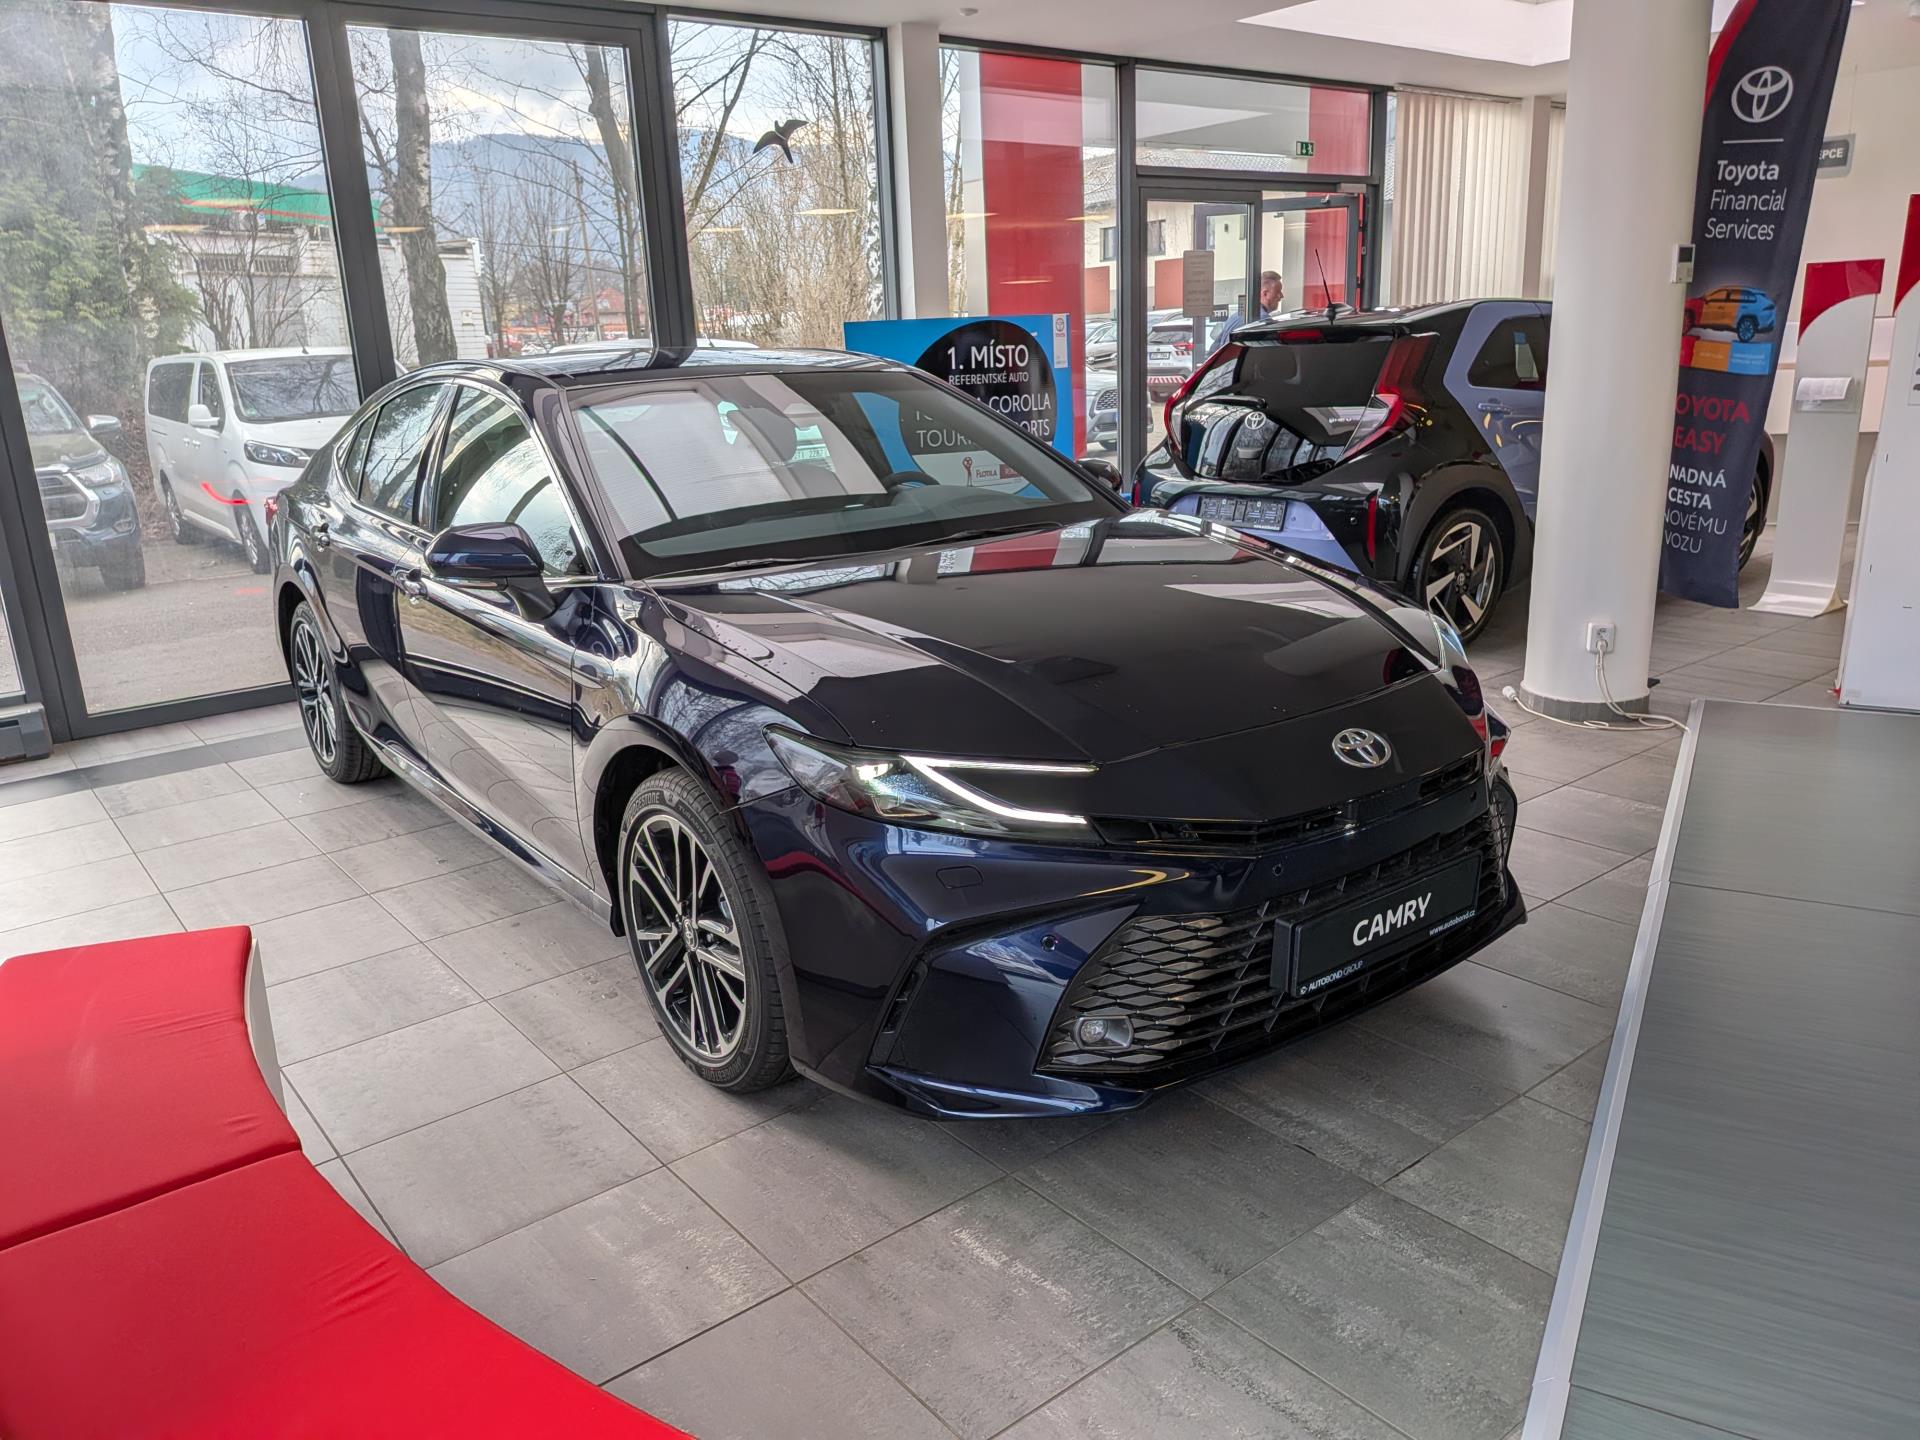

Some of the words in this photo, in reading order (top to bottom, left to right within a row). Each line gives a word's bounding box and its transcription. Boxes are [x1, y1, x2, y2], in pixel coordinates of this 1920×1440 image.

[1717, 160, 1780, 186] Toyota
[1710, 187, 1787, 212] Financial
[1705, 217, 1775, 241] Services
[947, 349, 964, 370] 1.
[971, 339, 1029, 369] MÍSTO
[948, 371, 1007, 386] REFERENTSKÉ
[1009, 371, 1029, 383] AUTO
[989, 393, 1052, 413] COROLLA
[1675, 392, 1752, 424] OYOTA
[1017, 419, 1050, 437] ORTS
[1674, 424, 1727, 456] EASY
[1669, 464, 1727, 489] NADNÁ
[1668, 486, 1712, 510] CESTA
[1664, 507, 1728, 535] NOVÉMU
[1664, 529, 1702, 554] VOZU
[1352, 892, 1432, 947] CAMRY
[1308, 969, 1343, 992] AUTOBOND
[1342, 960, 1364, 976] GROUP
